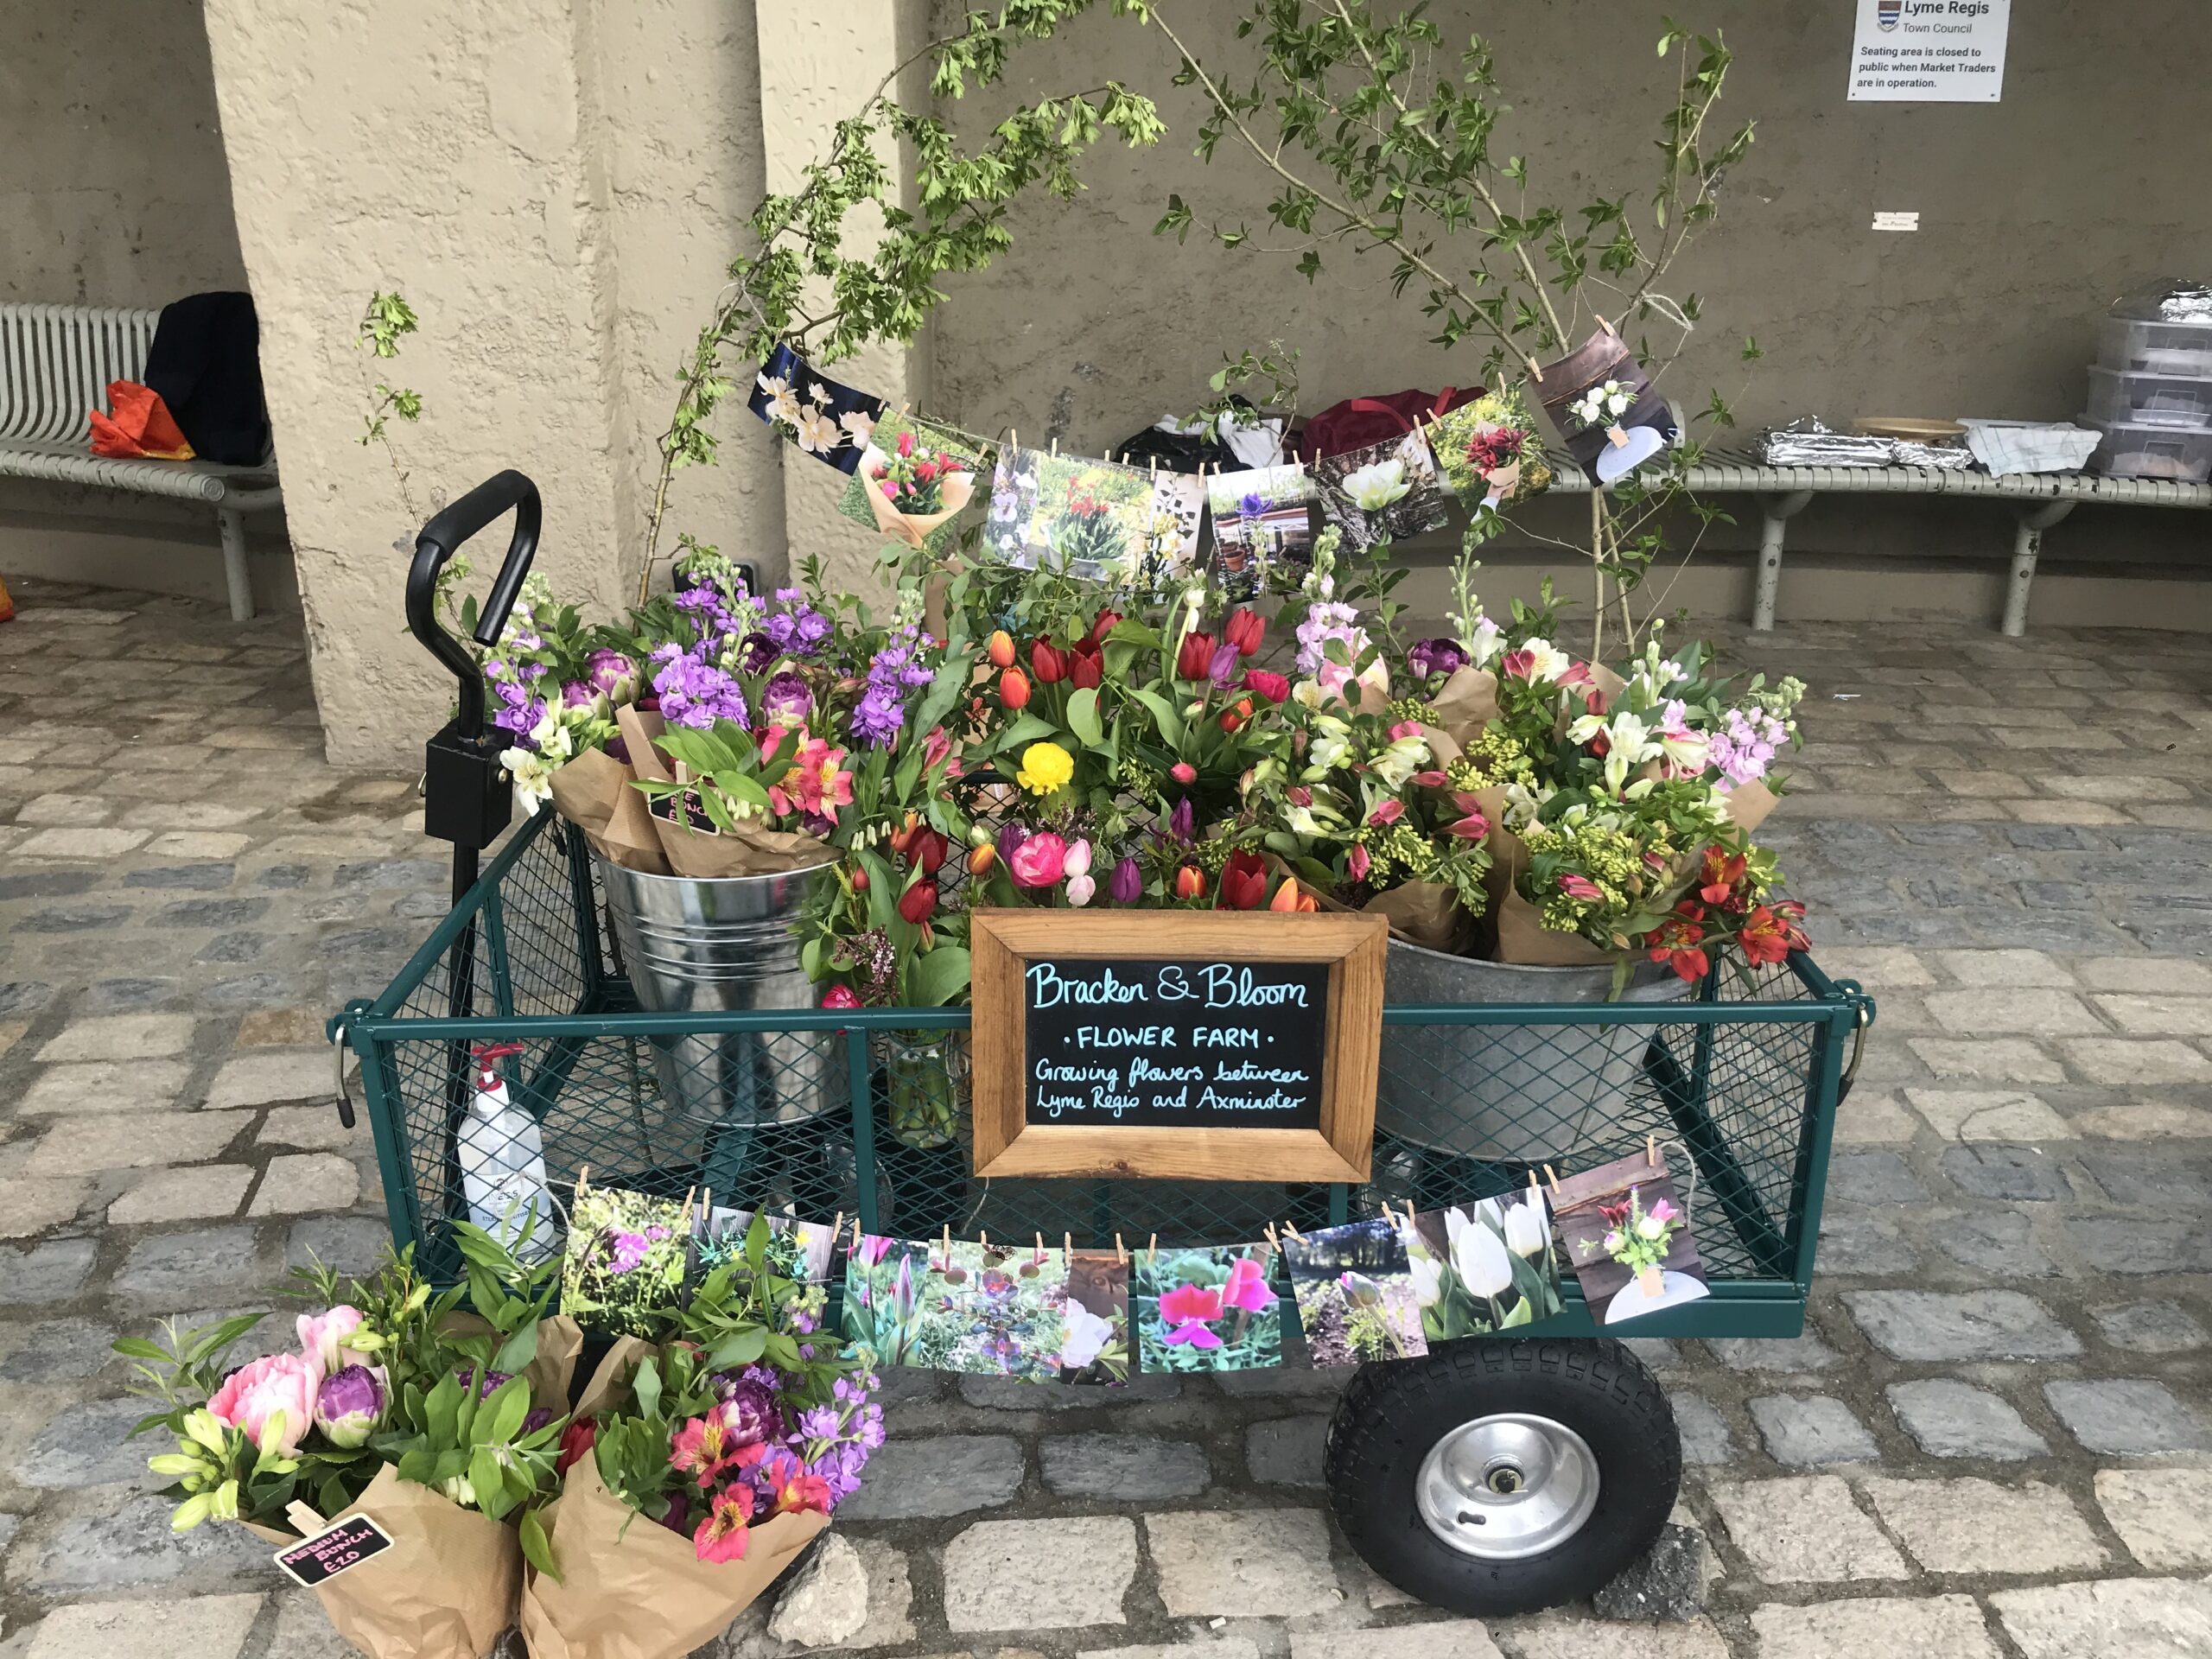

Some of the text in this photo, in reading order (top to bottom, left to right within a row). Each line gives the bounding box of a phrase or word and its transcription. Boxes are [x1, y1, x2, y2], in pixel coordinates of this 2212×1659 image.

[1904, 0, 1989, 16] Lyme Regis
[1904, 23, 1973, 34] Town Council
[1860, 47, 1898, 58] Seating
[1925, 48, 1933, 56] is
[1936, 48, 1968, 57] closed
[1971, 48, 1981, 57] to
[1859, 62, 1996, 73] public when Market Traders
[1875, 79, 1885, 87] in
[1887, 79, 1937, 89] operation.
[1026, 963, 1309, 1008] Bracken & Bloom
[1077, 1026, 1259, 1049] FLOWER FARM
[1035, 1056, 1310, 1093] Growing flowers between
[1037, 1085, 1306, 1118] Lyme Regis and Axminster
[283, 1529, 348, 1565] MEDIUM
[315, 1529, 373, 1561] BUNCH
[323, 1551, 359, 1573] £20
